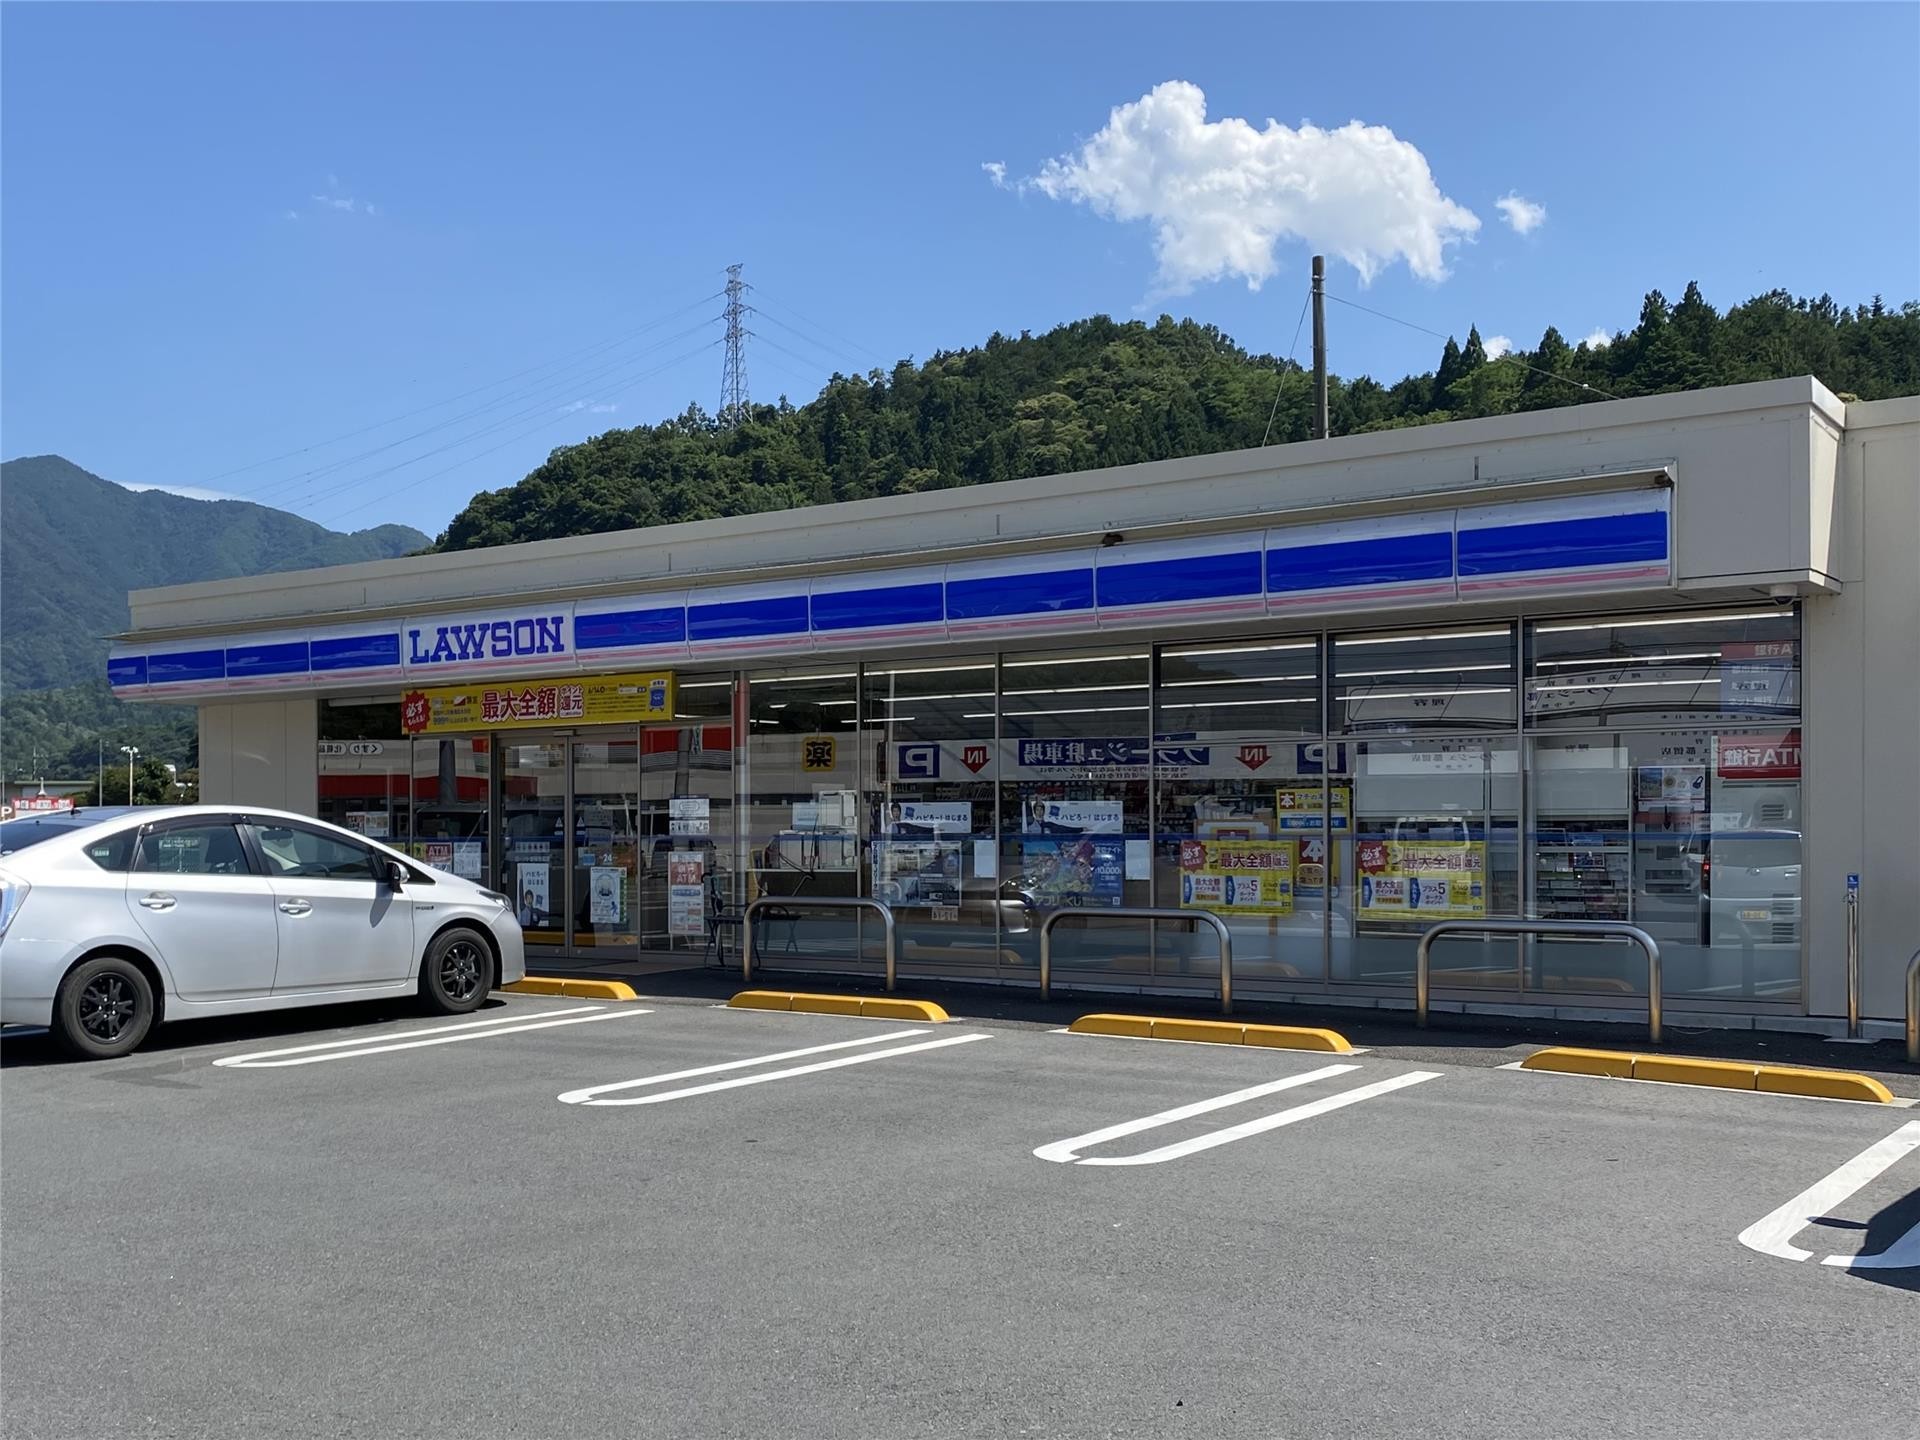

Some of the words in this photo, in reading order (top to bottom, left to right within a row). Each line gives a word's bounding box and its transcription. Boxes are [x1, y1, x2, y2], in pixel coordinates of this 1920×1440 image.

[408, 616, 565, 665] LAWSON
[406, 699, 425, 718] 必ず
[482, 686, 557, 720] 最大全額
[560, 694, 583, 711] 還元
[1280, 793, 1295, 808] 本
[945, 813, 969, 822] はじまる
[1093, 813, 1121, 822] はじまる
[428, 845, 449, 857] ATM
[602, 853, 613, 863] 24
[1183, 847, 1201, 859] 必ず
[1361, 847, 1381, 860] 必ず
[1221, 853, 1272, 869] 最大全額
[1402, 851, 1462, 871] 最大全額
